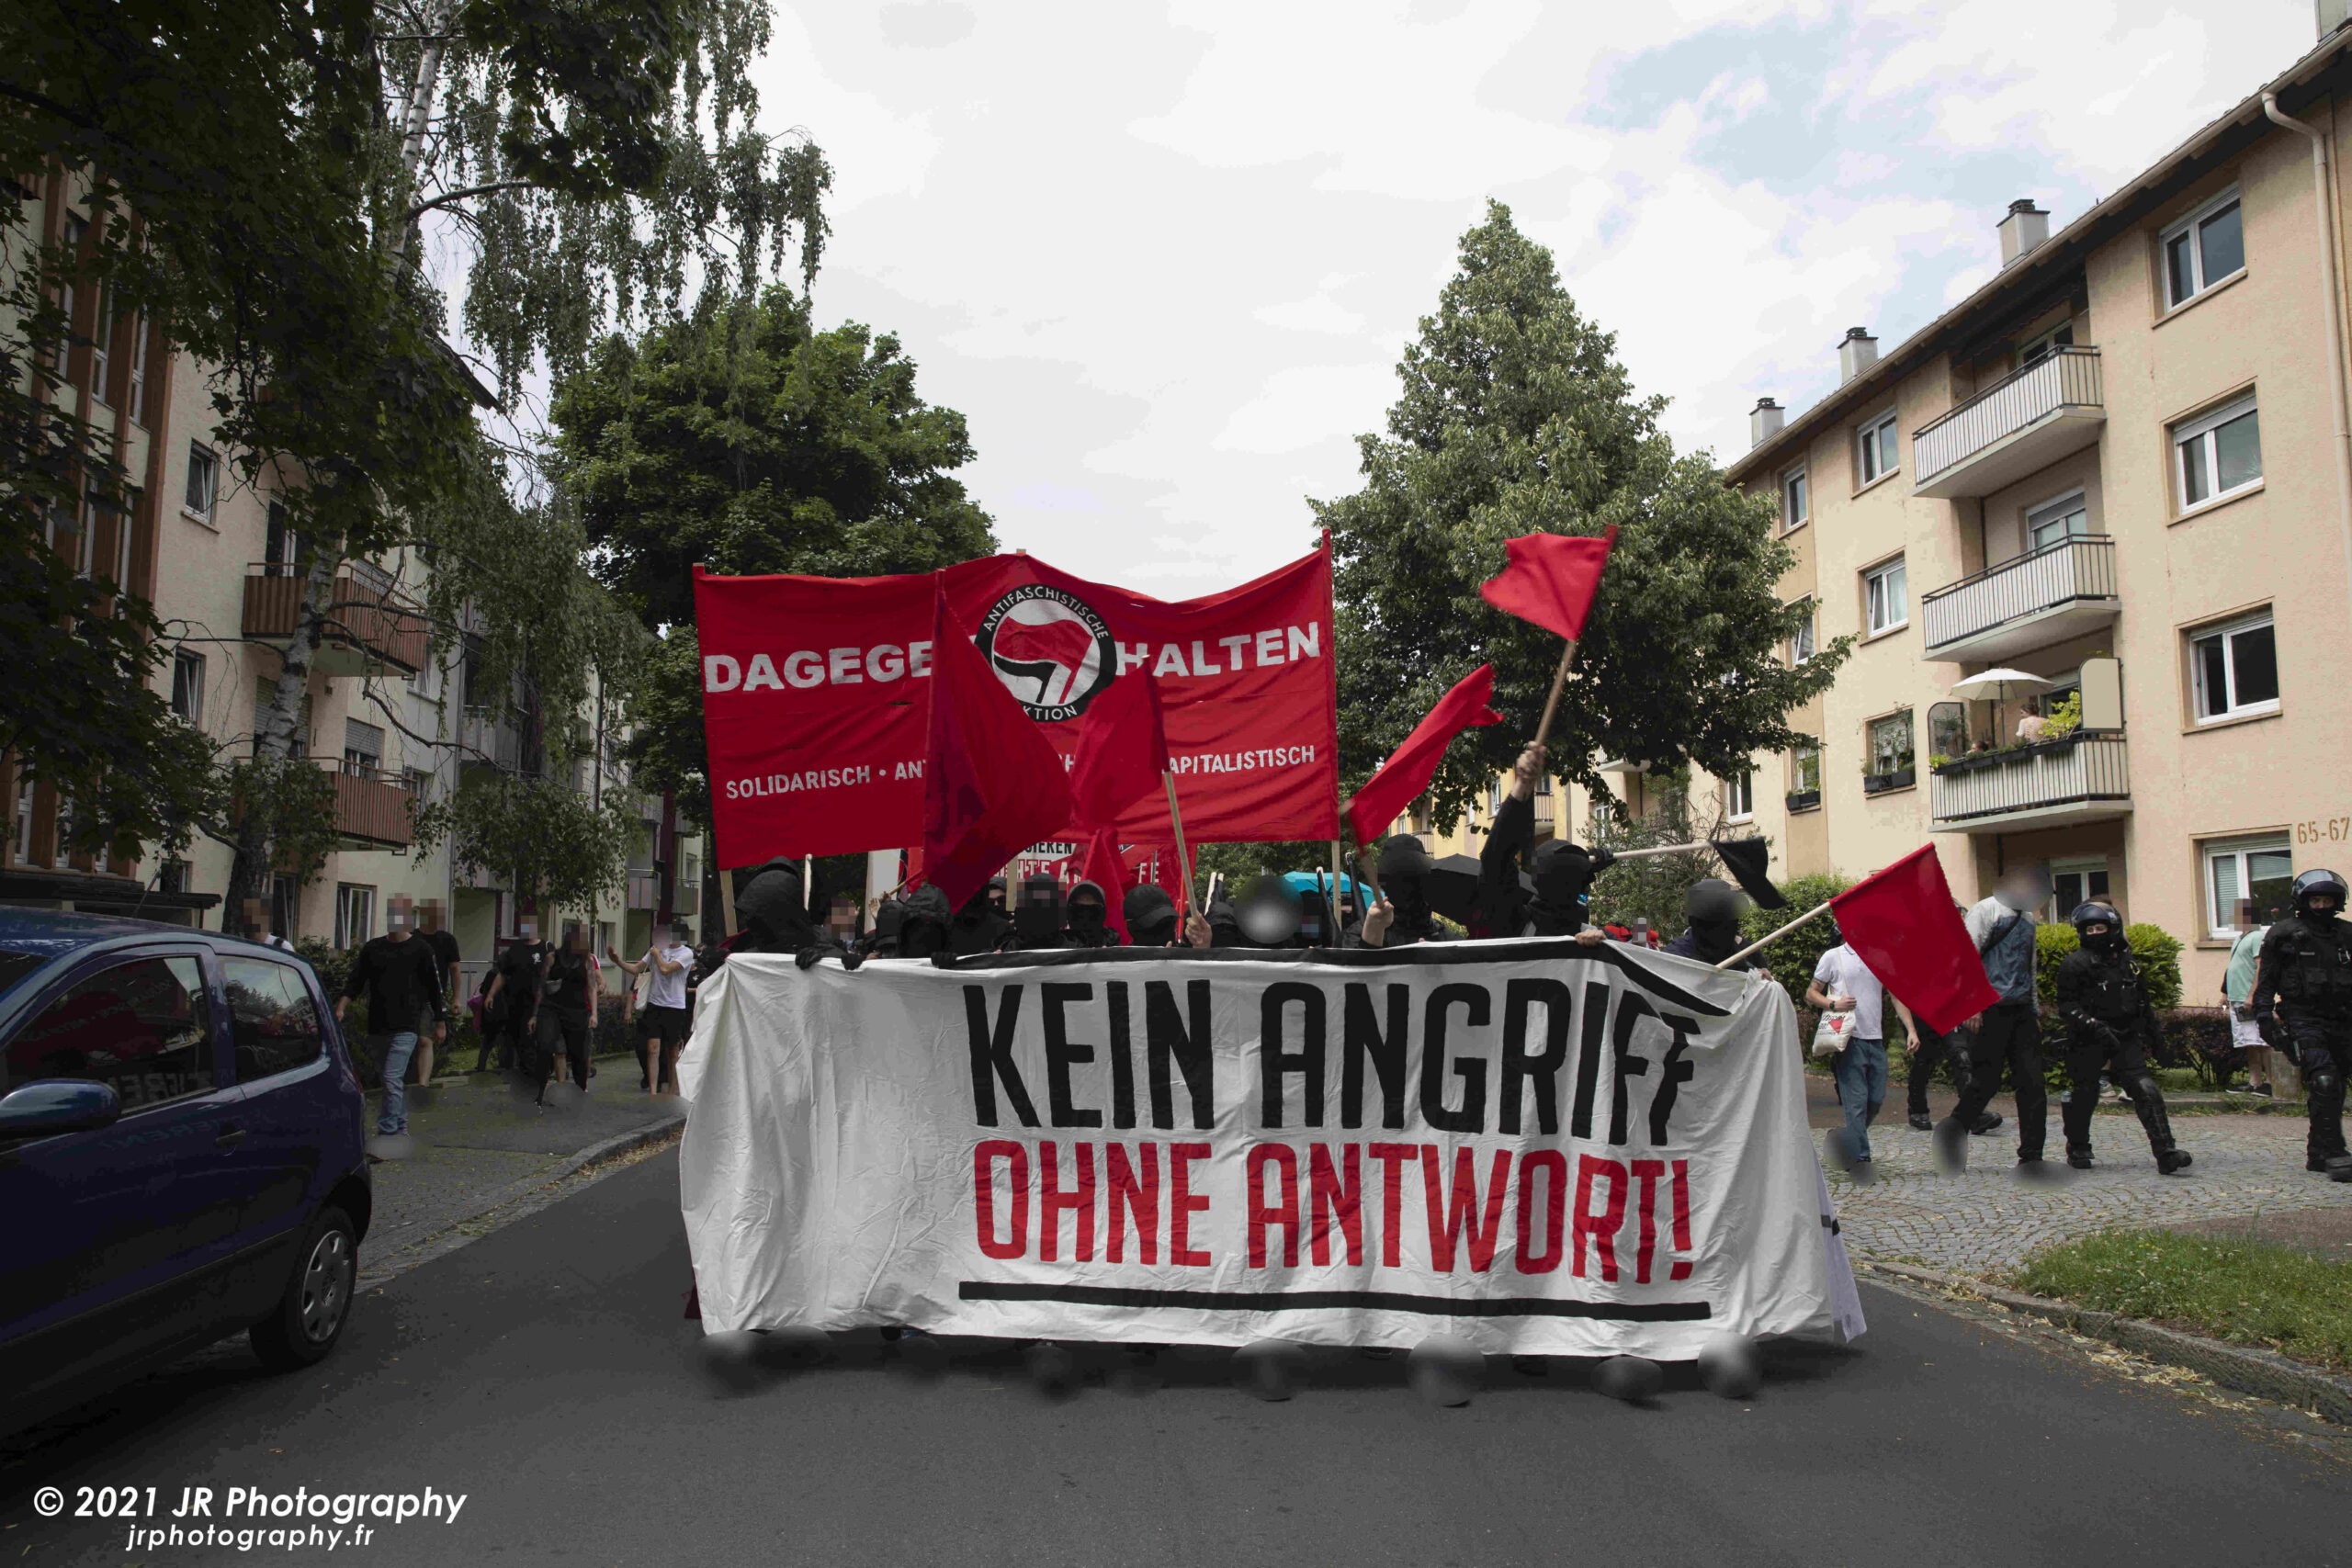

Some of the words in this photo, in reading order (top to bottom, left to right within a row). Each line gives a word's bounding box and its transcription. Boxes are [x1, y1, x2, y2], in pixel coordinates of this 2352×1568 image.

[983, 585, 1109, 639] ANTIFASCHISTISCHE
[705, 640, 933, 693] DAGEGE
[1114, 621, 1321, 678] HALTEN
[1022, 705, 1078, 721] KTION
[726, 764, 871, 800] SOLIDARISCH
[894, 759, 927, 781] AN
[1161, 745, 1315, 775] APITALISTISCH
[2297, 817, 2350, 844] 65-67
[963, 979, 1216, 1131] KEIN
[1260, 977, 1701, 1146] ANGRIFF
[975, 1139, 1212, 1267] OHNE
[1248, 1142, 1692, 1283] ANTWORT!
